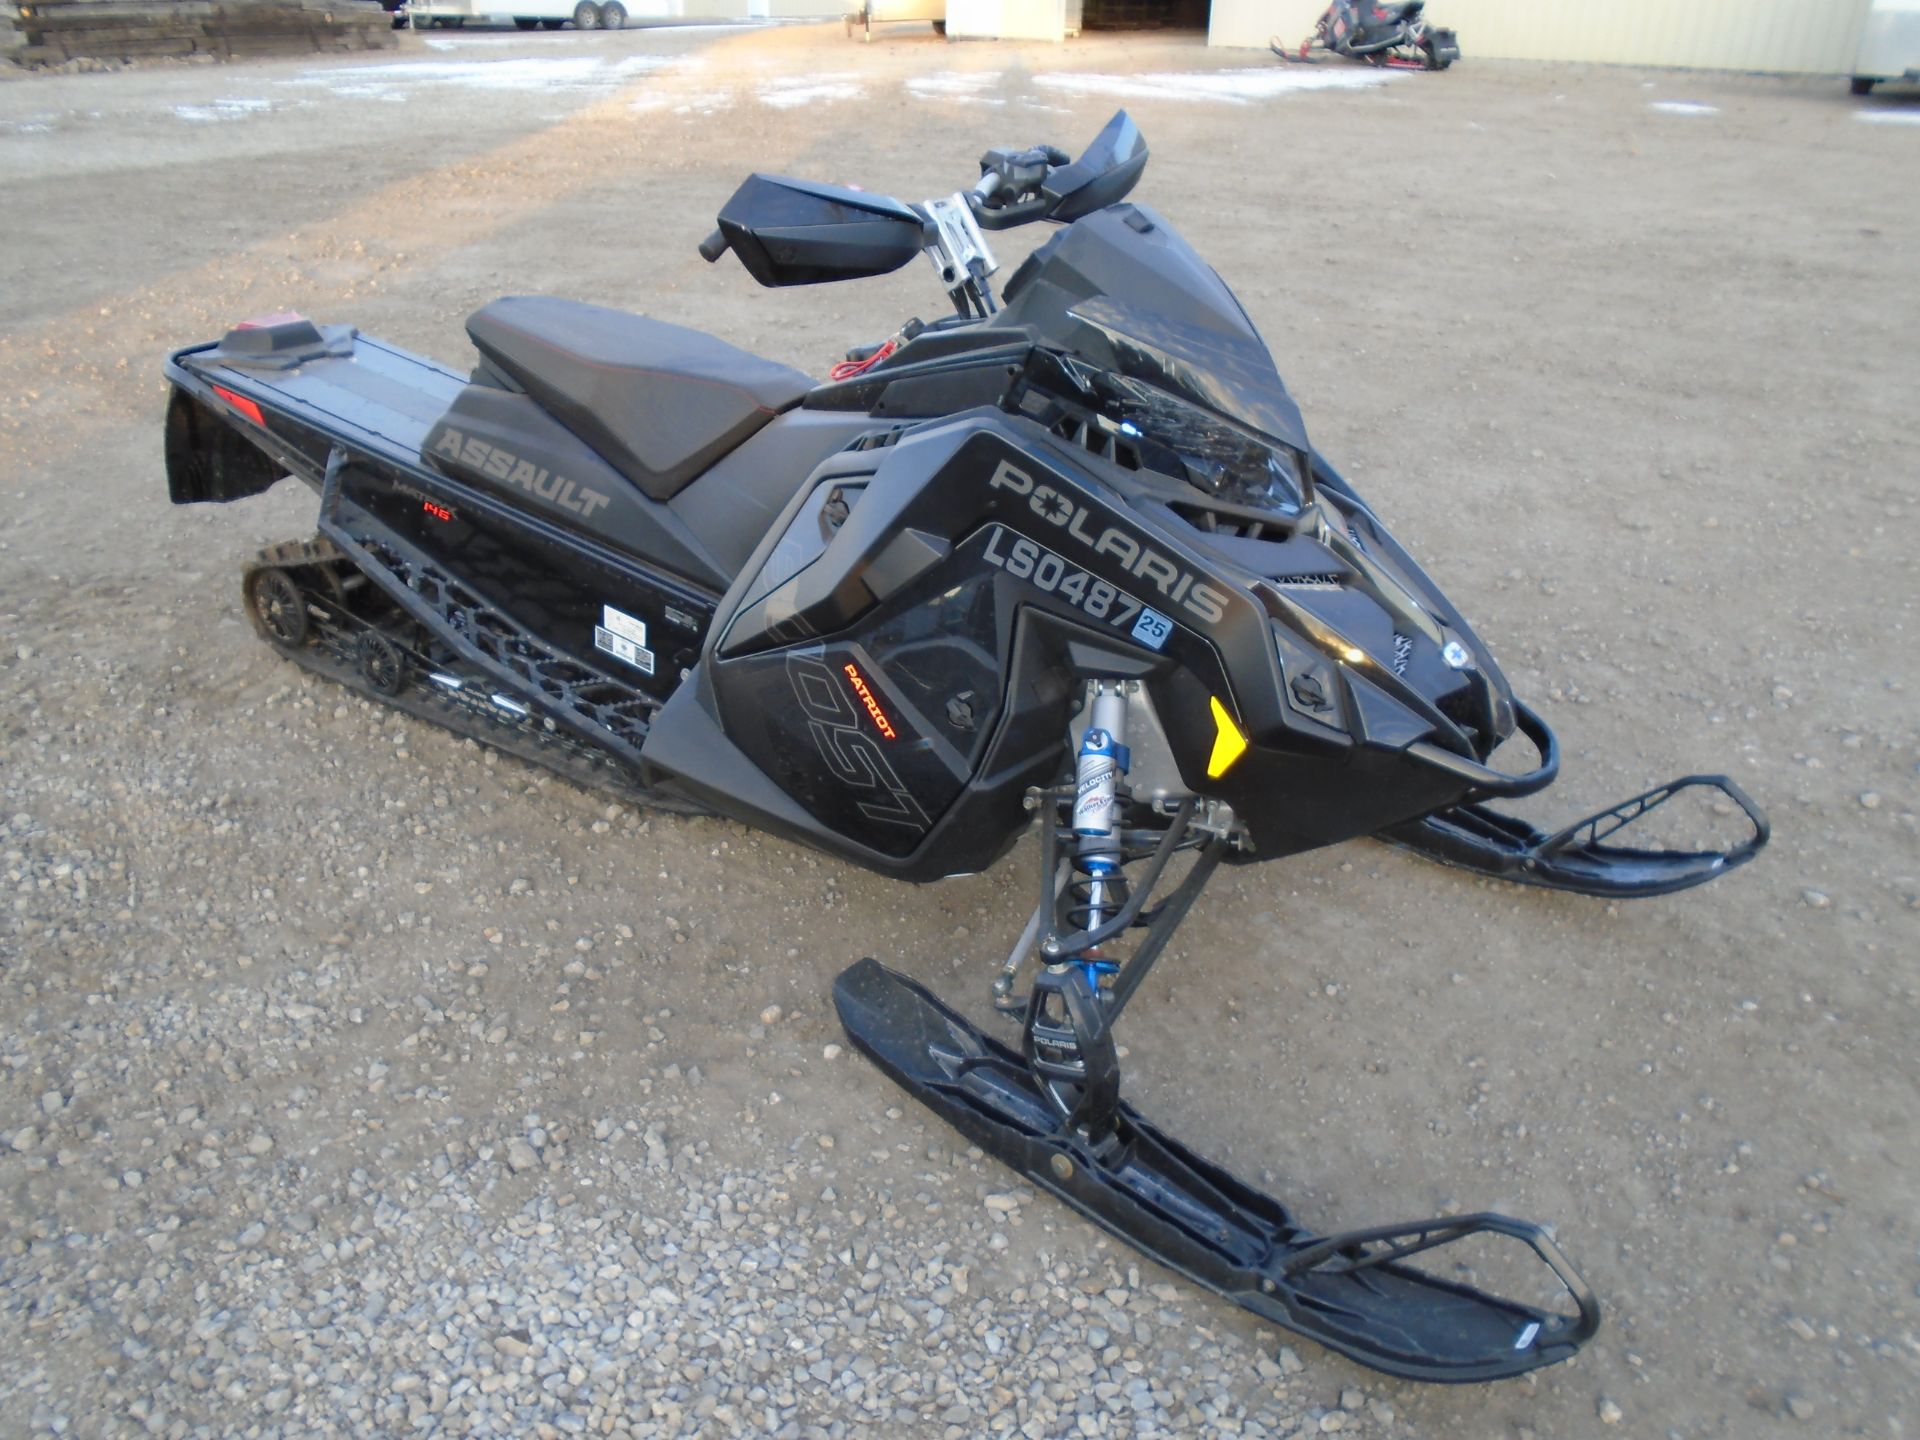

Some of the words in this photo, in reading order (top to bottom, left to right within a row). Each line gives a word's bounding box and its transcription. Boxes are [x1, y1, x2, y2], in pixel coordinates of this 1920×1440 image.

[434, 427, 611, 517] ASSAULT
[423, 501, 452, 522] 146
[989, 458, 1229, 624] POLARIS
[983, 526, 1141, 627] LS0487
[1138, 614, 1166, 638] 25
[843, 663, 896, 739] PATRIOT
[1077, 771, 1113, 795] VELOCITY
[1033, 1036, 1077, 1050] POLARIS
